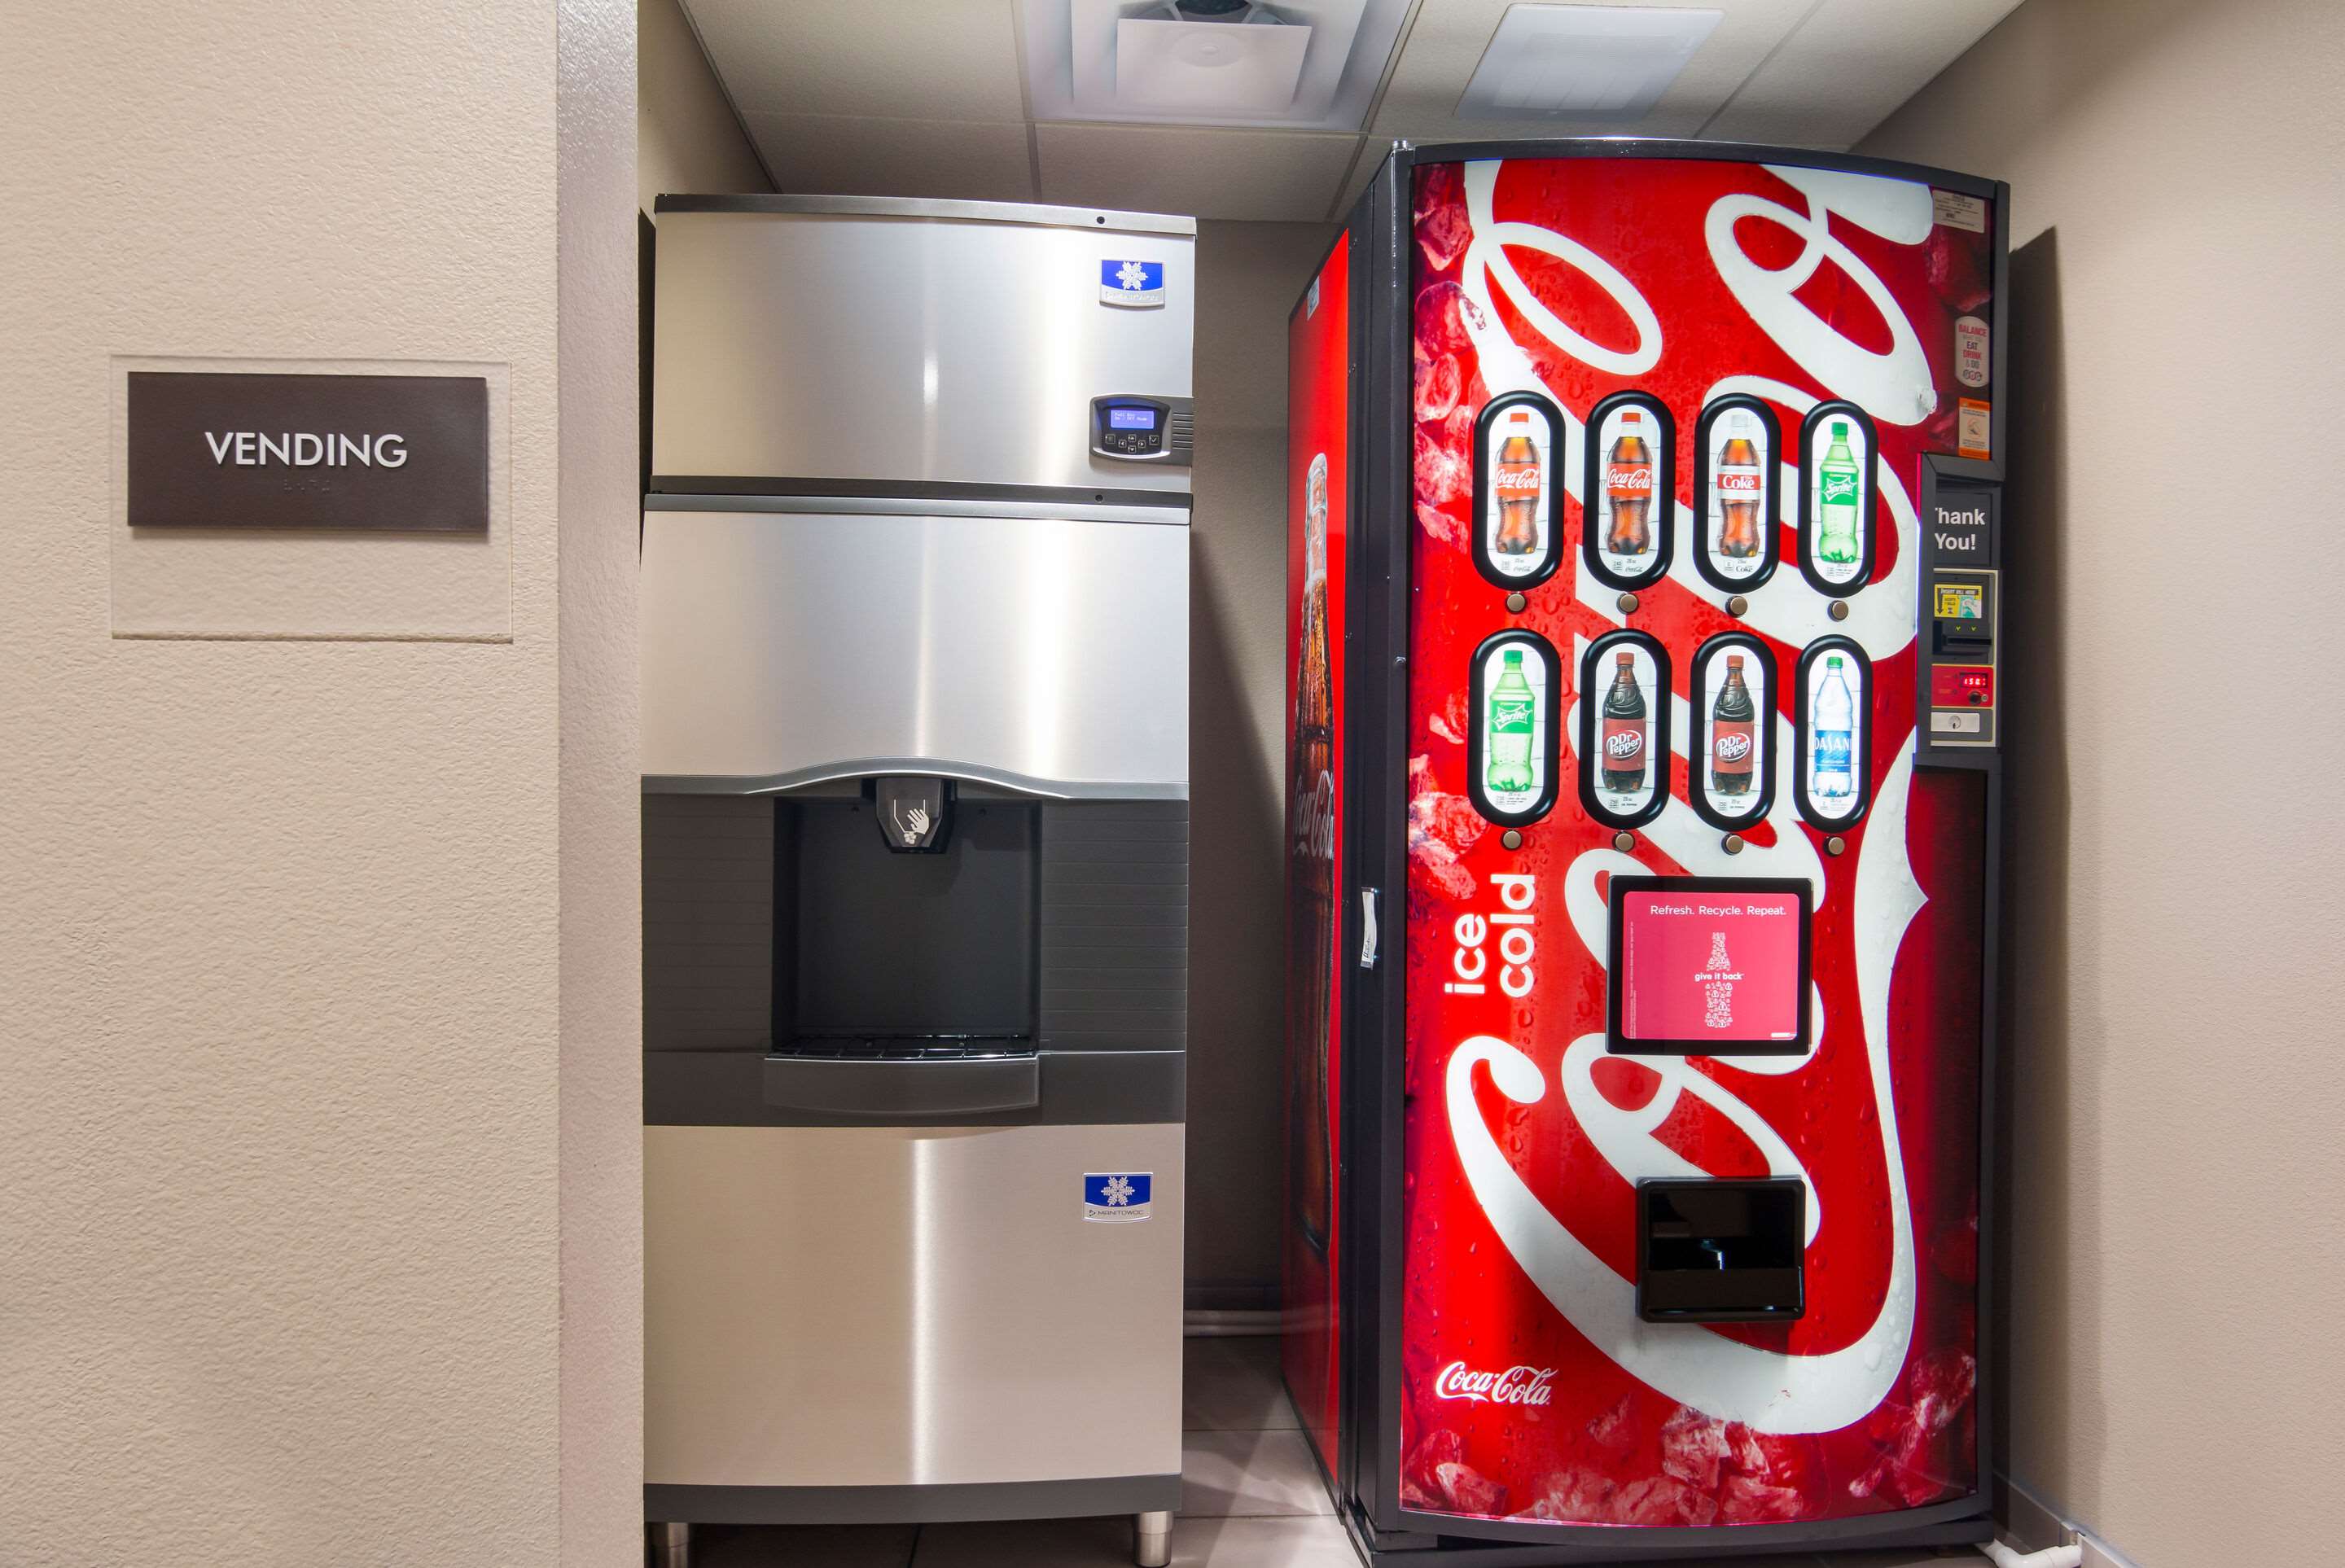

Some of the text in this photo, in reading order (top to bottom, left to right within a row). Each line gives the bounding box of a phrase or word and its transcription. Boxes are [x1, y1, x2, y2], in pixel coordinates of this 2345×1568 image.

[1966, 340, 1978, 350] EAT
[204, 431, 407, 468] VENDING
[1497, 468, 1539, 489] Coca-Cola
[1608, 468, 1650, 489] Coca-Cola
[1722, 475, 1755, 489] Coke
[1826, 482, 1852, 494] Sprite
[1935, 507, 1986, 525] hank
[1934, 532, 1976, 550] You!
[1498, 707, 1527, 724] Sprite
[1608, 735, 1641, 755] Pepper
[1619, 734, 1633, 744] Dr
[1716, 738, 1749, 757] Pepper
[1727, 735, 1740, 746] Dr
[1814, 735, 1852, 754] DASANI
[1650, 905, 1786, 917] Refresh. Recycle. Repeat.
[1489, 874, 1536, 997] cold
[1444, 913, 1487, 994] ice
[1694, 972, 1712, 982] give
[1714, 972, 1720, 980] it
[1435, 1361, 1558, 1405] Coca-Cola
